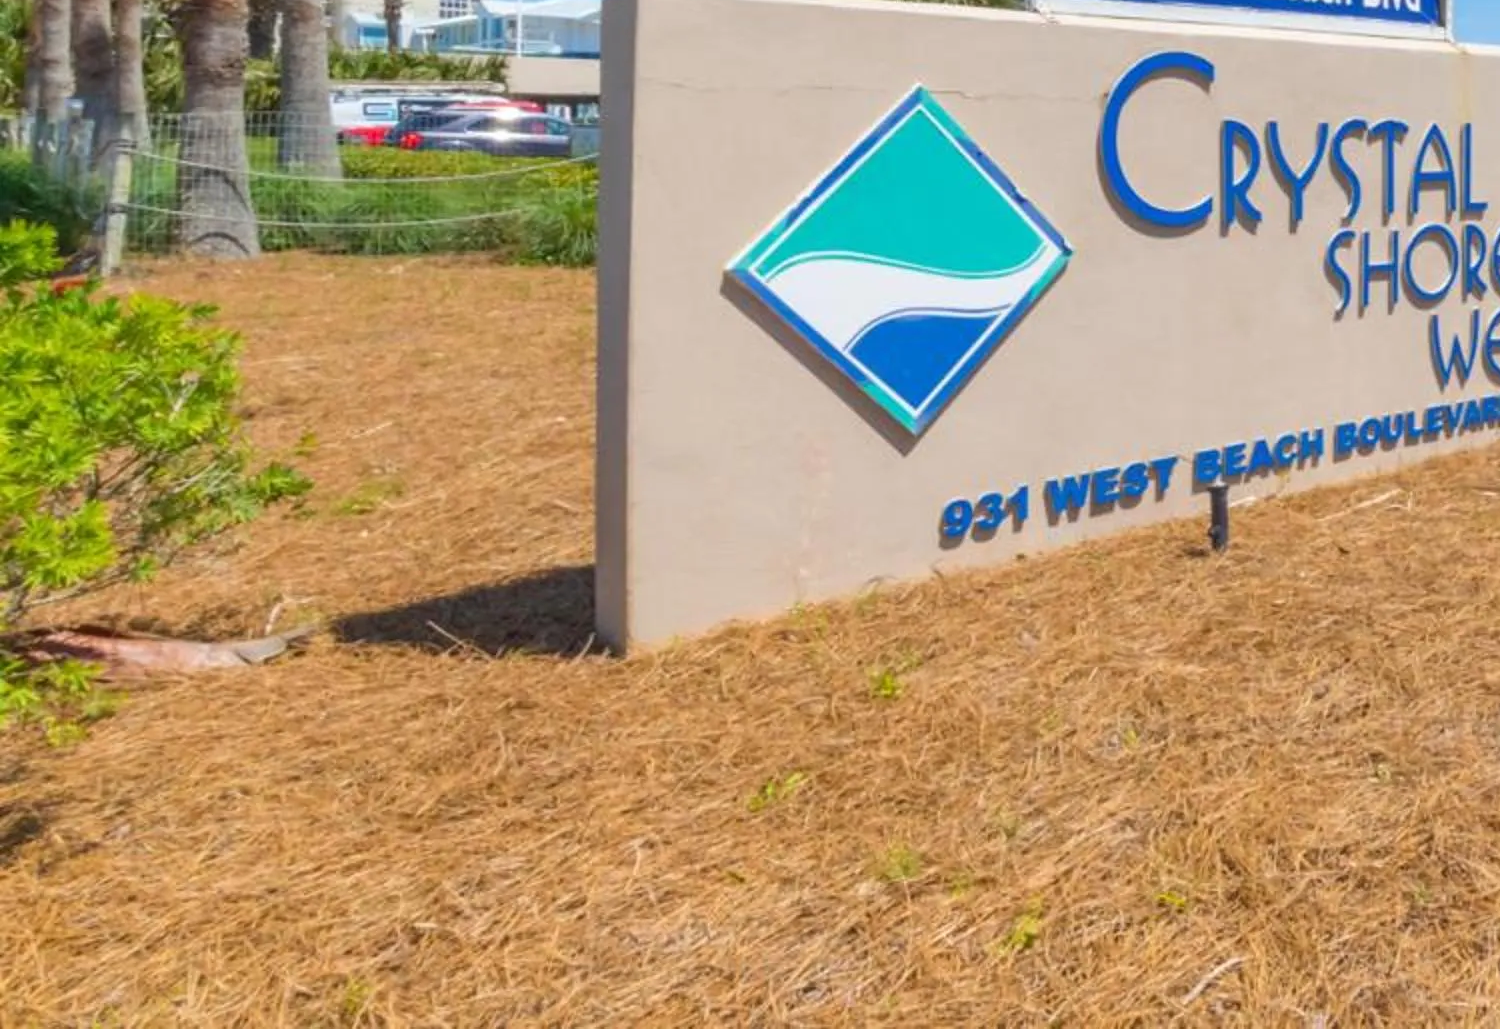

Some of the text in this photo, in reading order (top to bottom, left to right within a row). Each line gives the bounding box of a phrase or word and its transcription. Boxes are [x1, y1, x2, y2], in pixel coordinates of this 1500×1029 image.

[1098, 50, 1489, 228] CRYSTAL
[940, 485, 1029, 539] 931
[1046, 455, 1180, 515] WEST
[1196, 428, 1325, 484] BEACH
